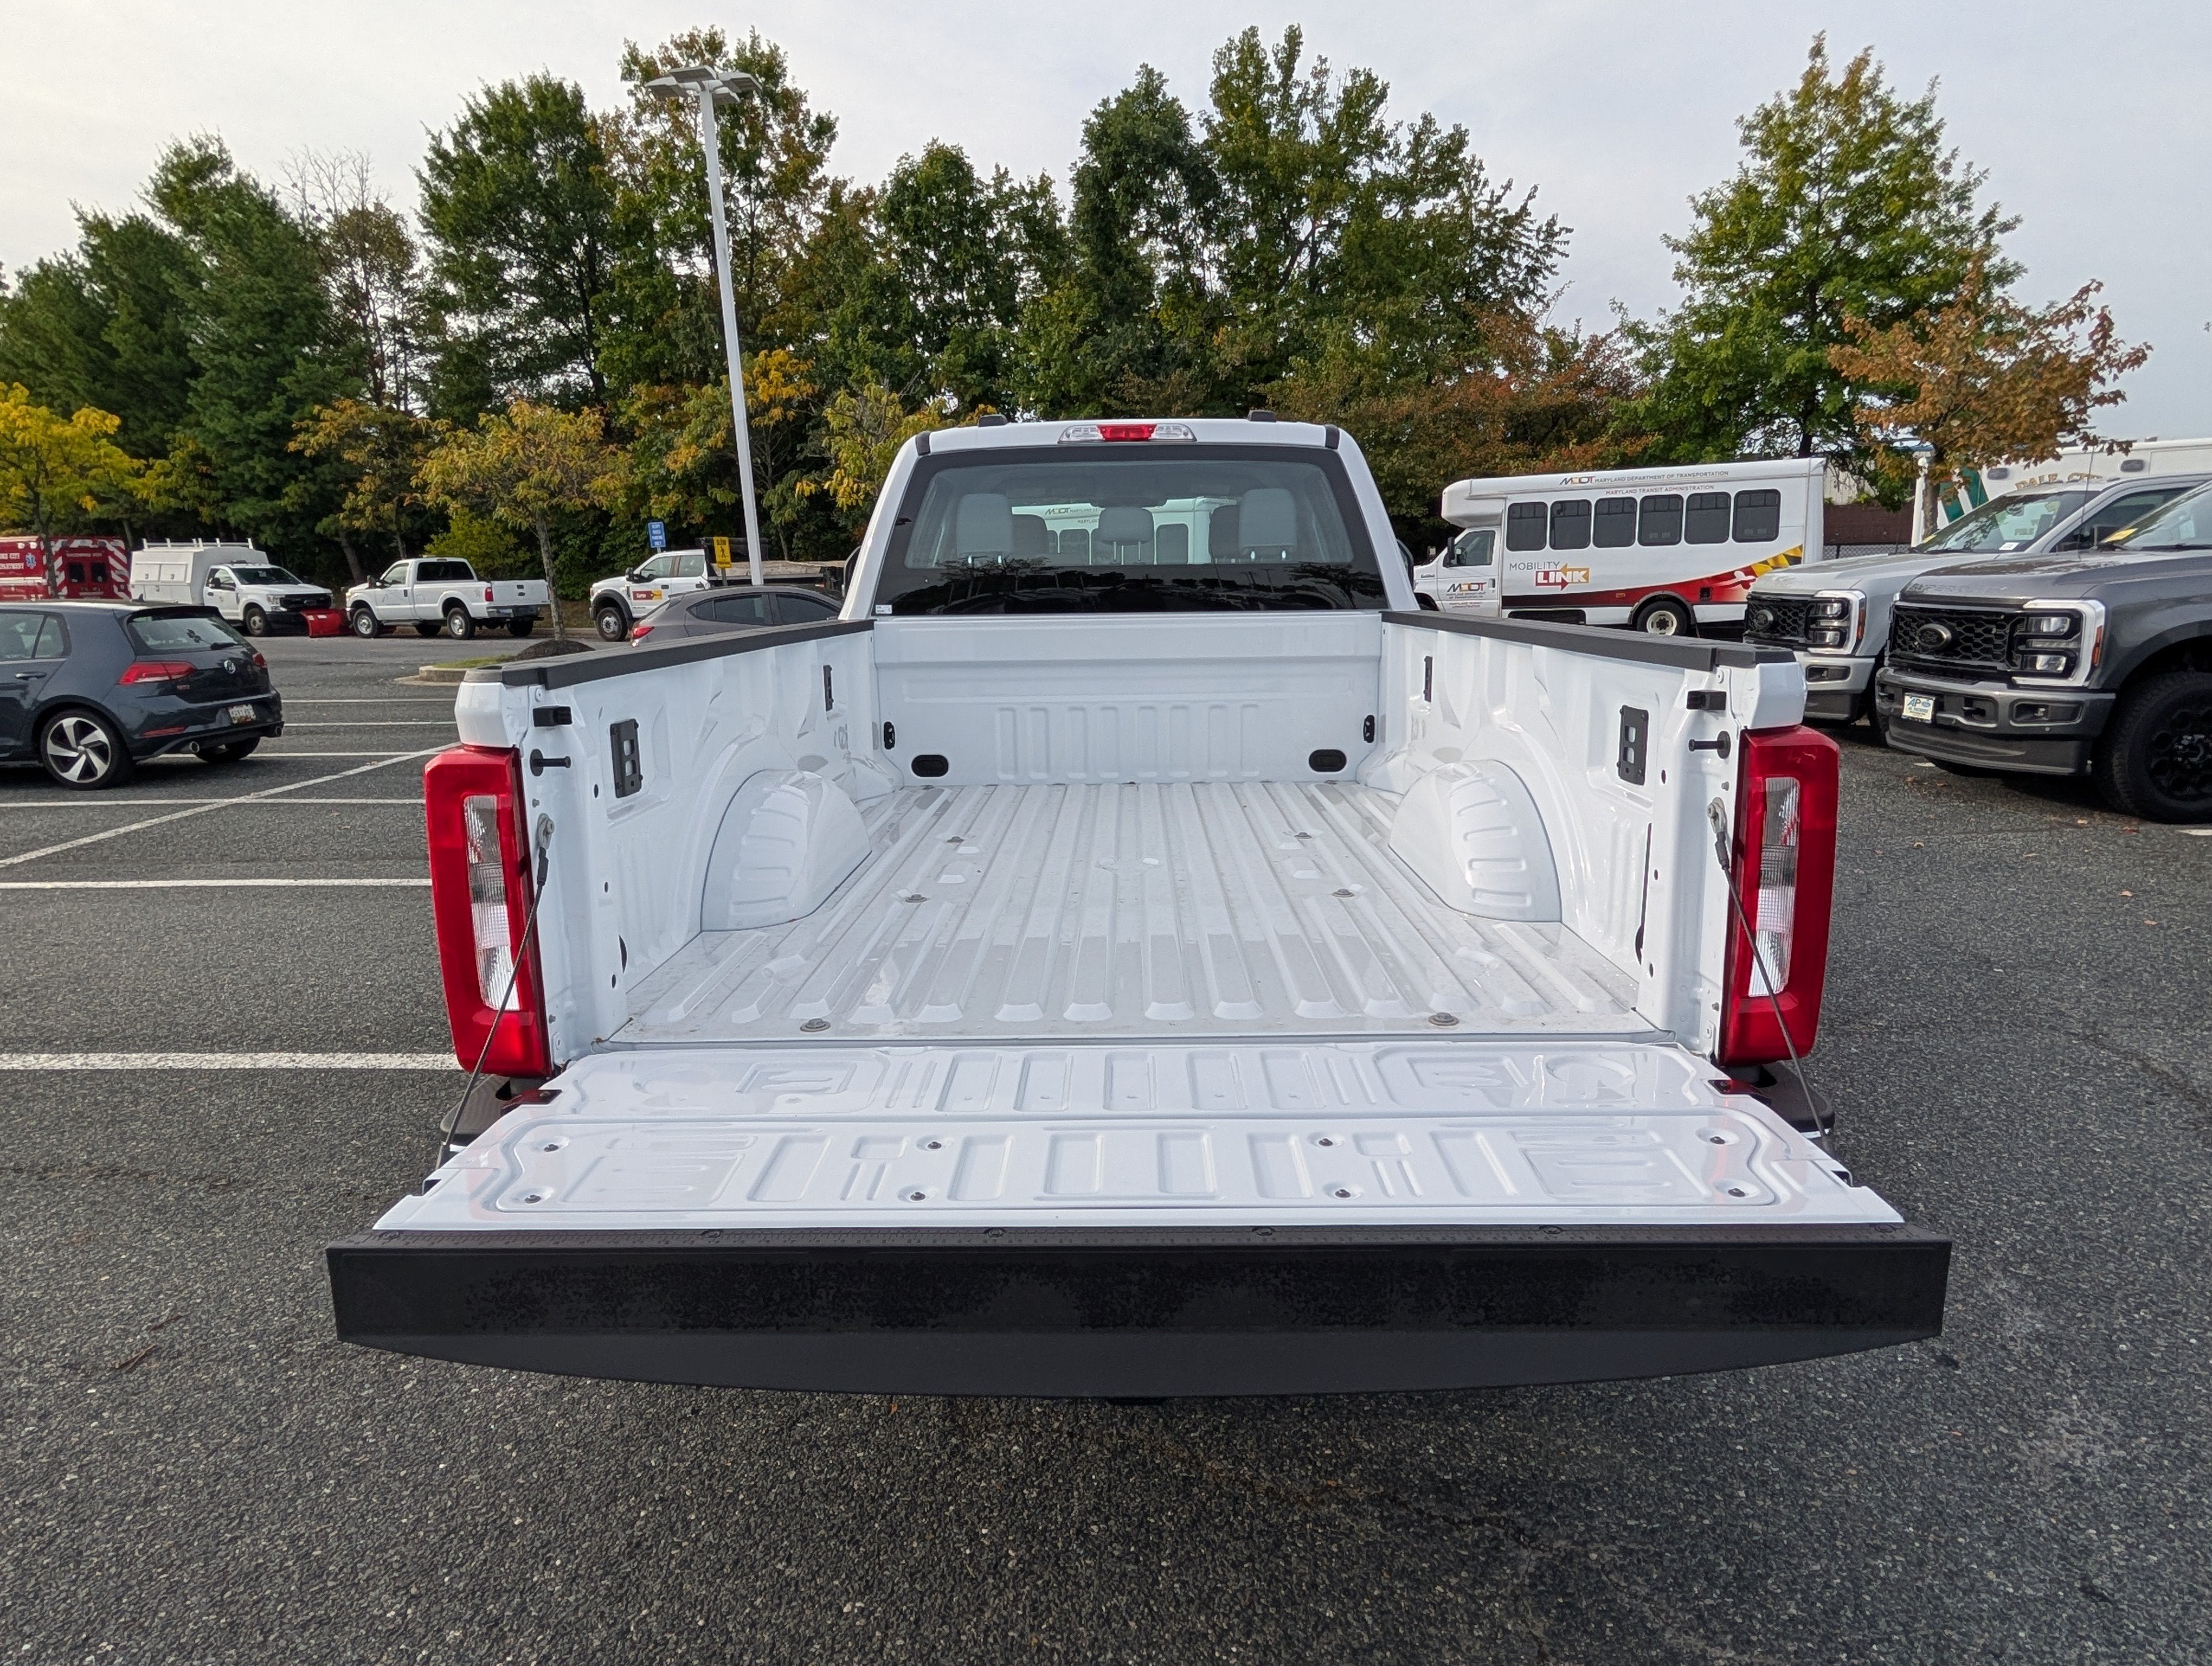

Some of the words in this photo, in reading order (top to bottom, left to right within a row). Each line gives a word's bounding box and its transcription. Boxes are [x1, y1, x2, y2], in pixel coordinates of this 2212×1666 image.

[1627, 473, 1665, 482] DEPARTMENT
[1509, 561, 1560, 571] MOBILITY
[1537, 570, 1588, 583] LINK
